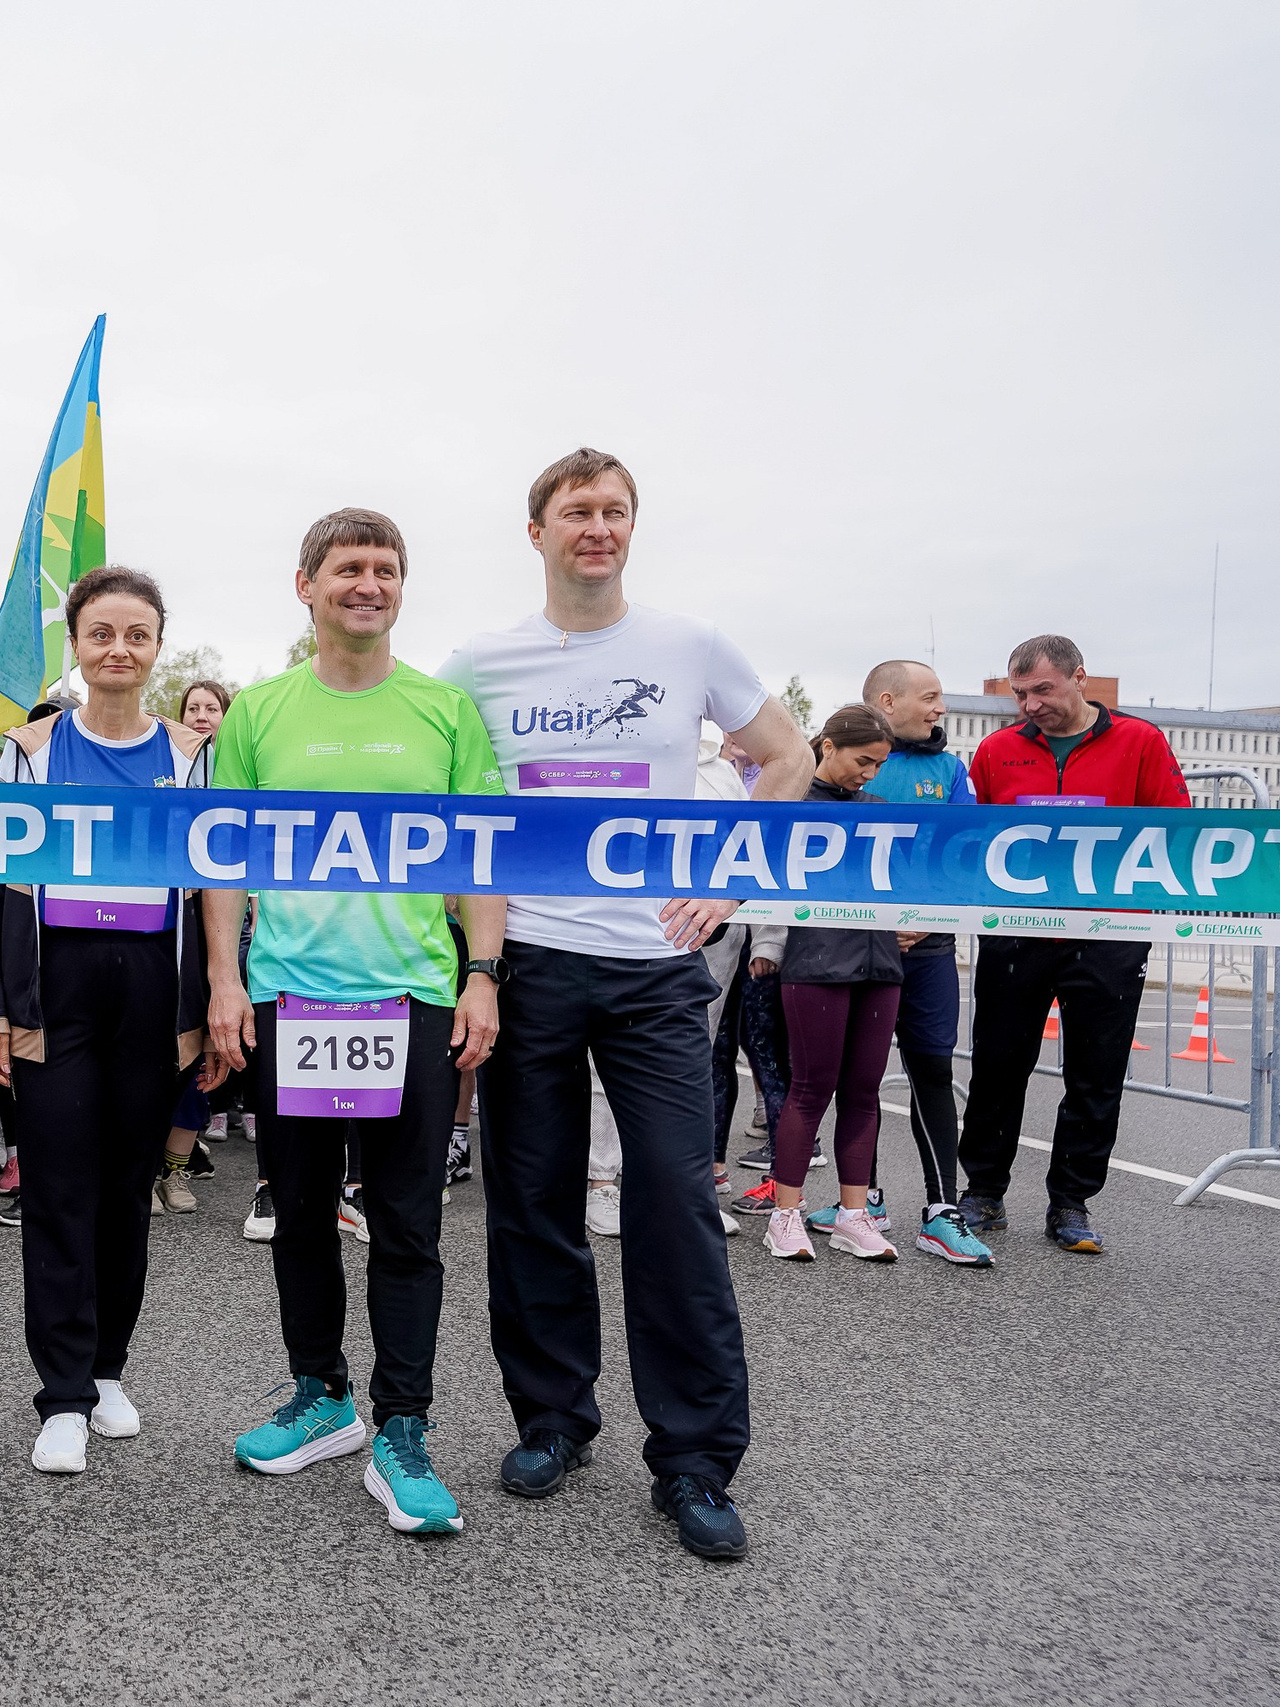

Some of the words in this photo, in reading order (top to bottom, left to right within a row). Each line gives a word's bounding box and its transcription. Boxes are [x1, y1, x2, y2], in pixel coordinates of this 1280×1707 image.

[512, 703, 602, 736] Utair
[189, 807, 516, 886] СТАРТ
[587, 817, 916, 891] СТАРТ
[985, 824, 1280, 896] СТАР
[813, 906, 876, 919] СБЕРБАНК
[1002, 914, 1067, 928] СБЕРБАНК
[1196, 923, 1263, 936] СБЕРБАНК
[297, 1035, 395, 1071] 2185
